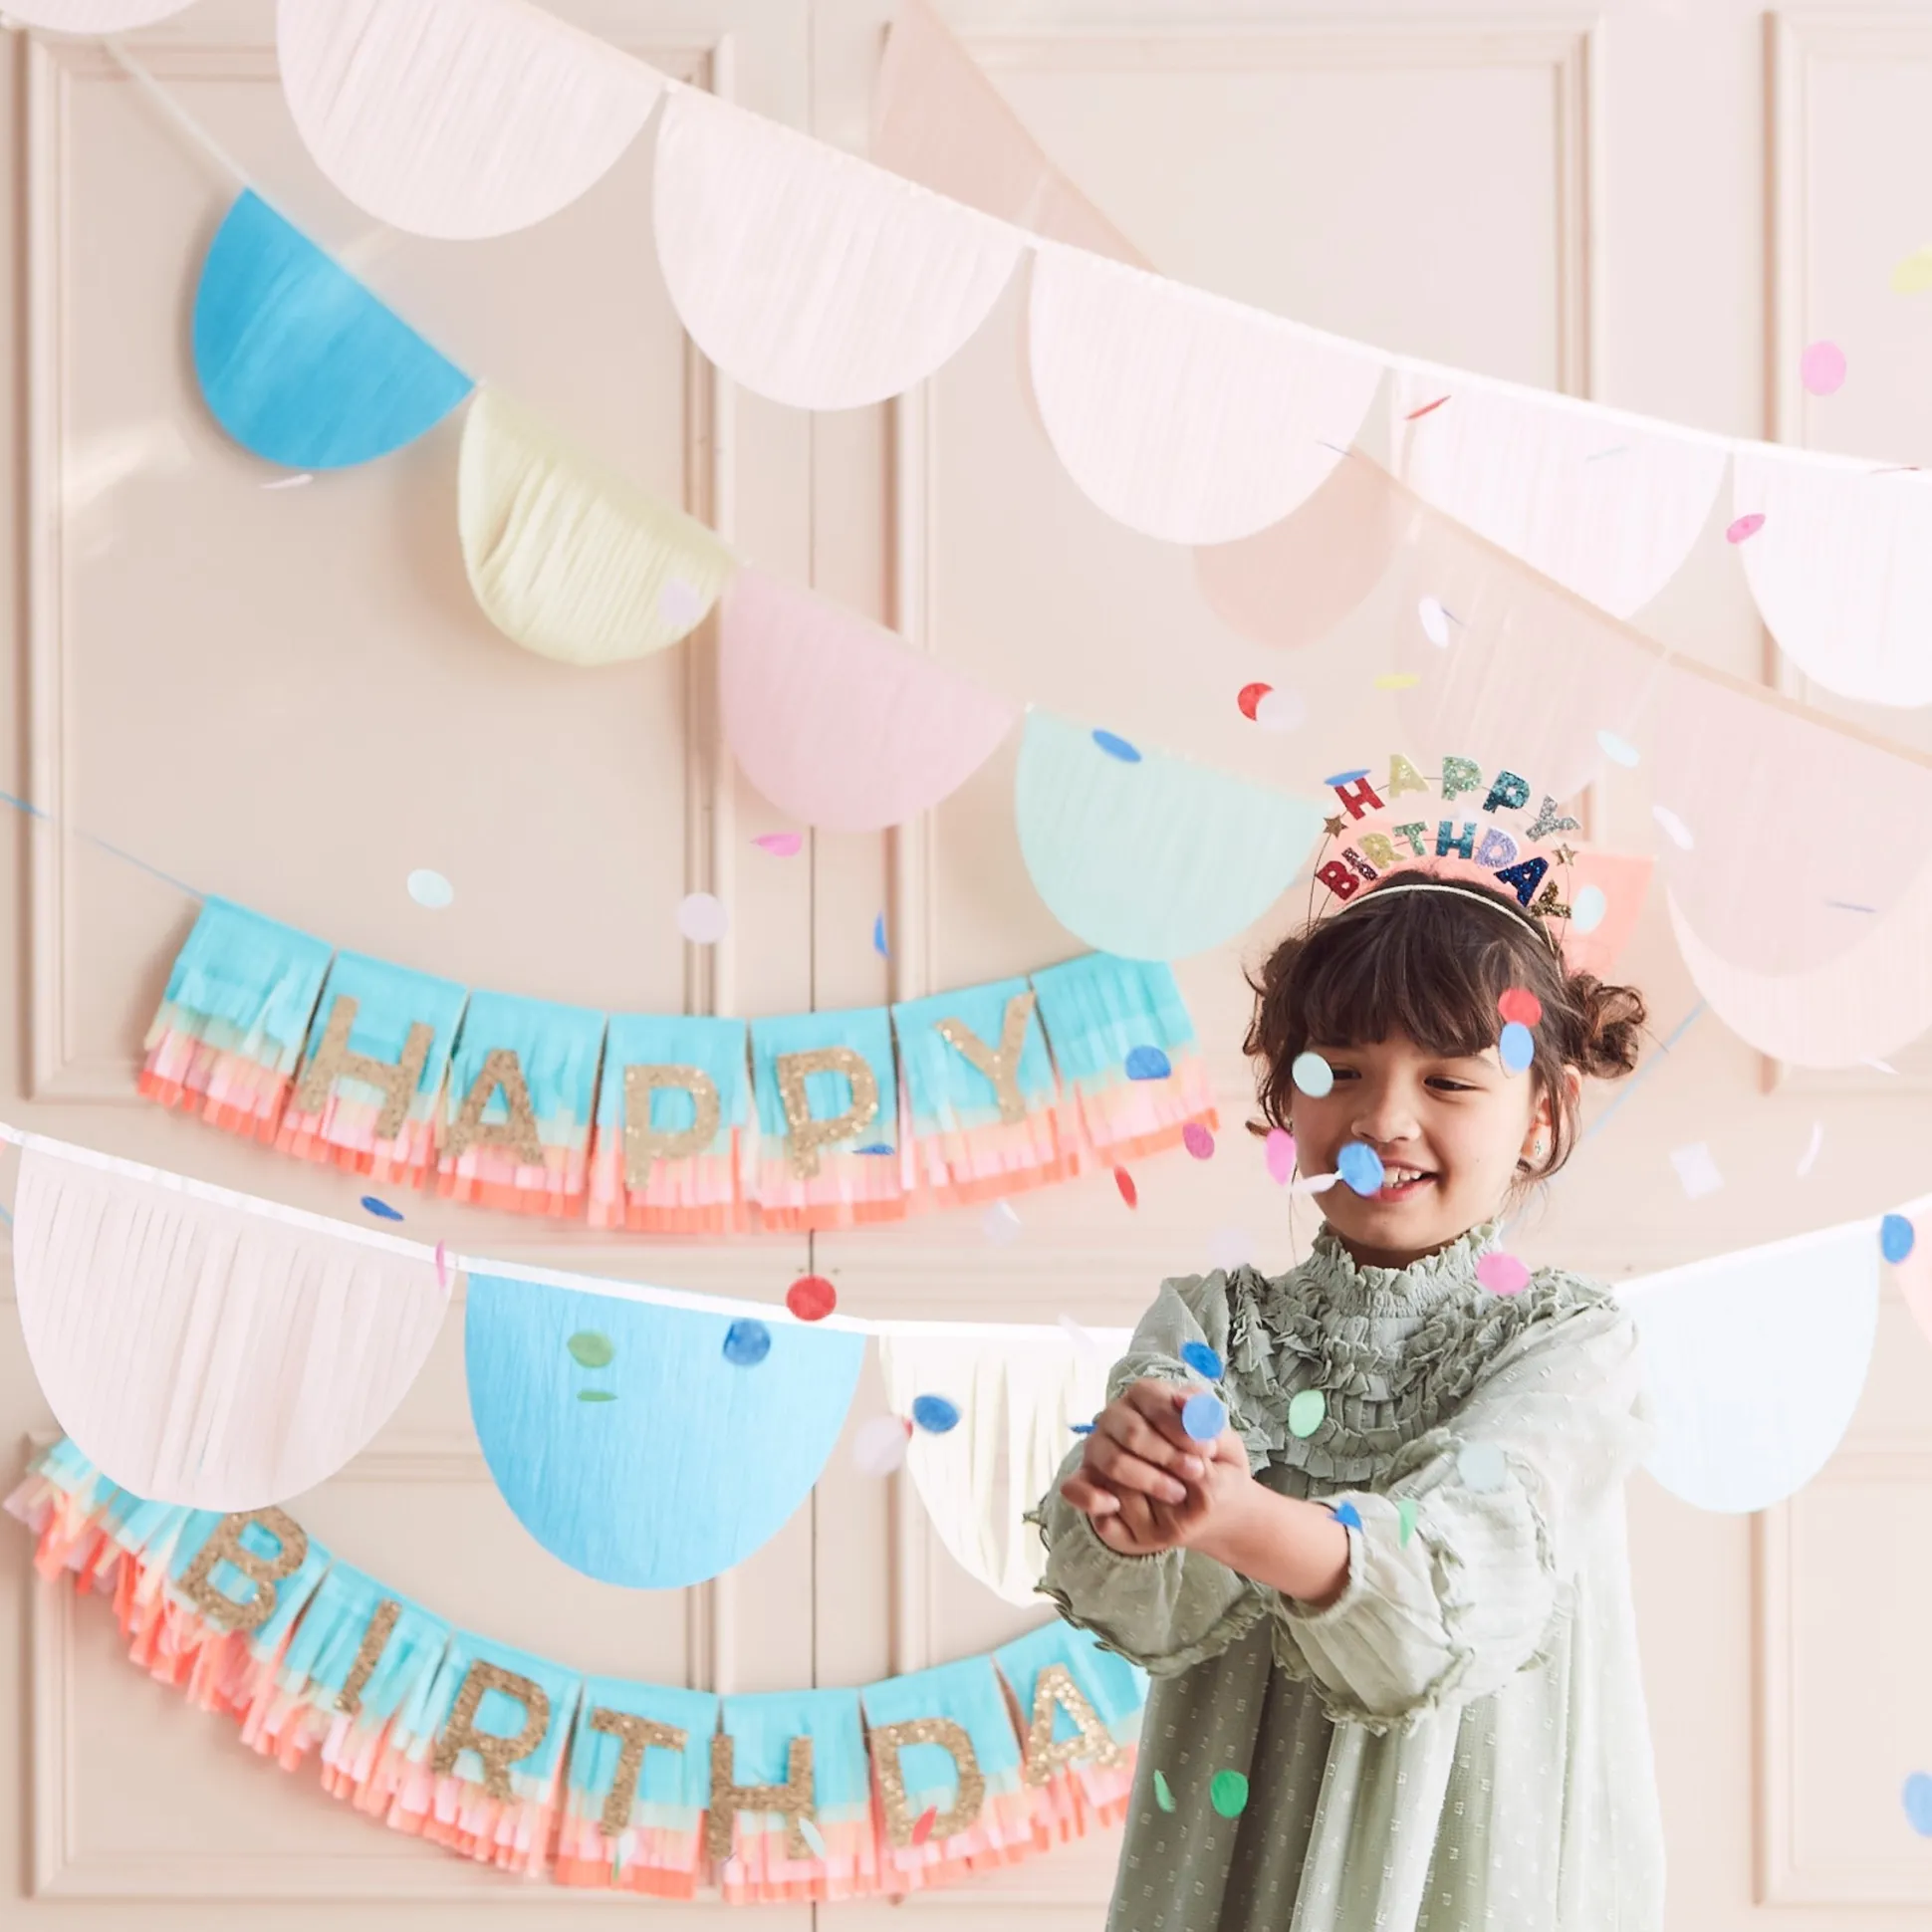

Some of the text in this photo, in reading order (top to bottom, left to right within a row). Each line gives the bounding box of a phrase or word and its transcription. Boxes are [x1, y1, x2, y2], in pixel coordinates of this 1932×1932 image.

[1332, 753, 1581, 843] HAPPY
[1316, 821, 1571, 919] BIRTHDAY
[295, 994, 1037, 1191] HAPPY
